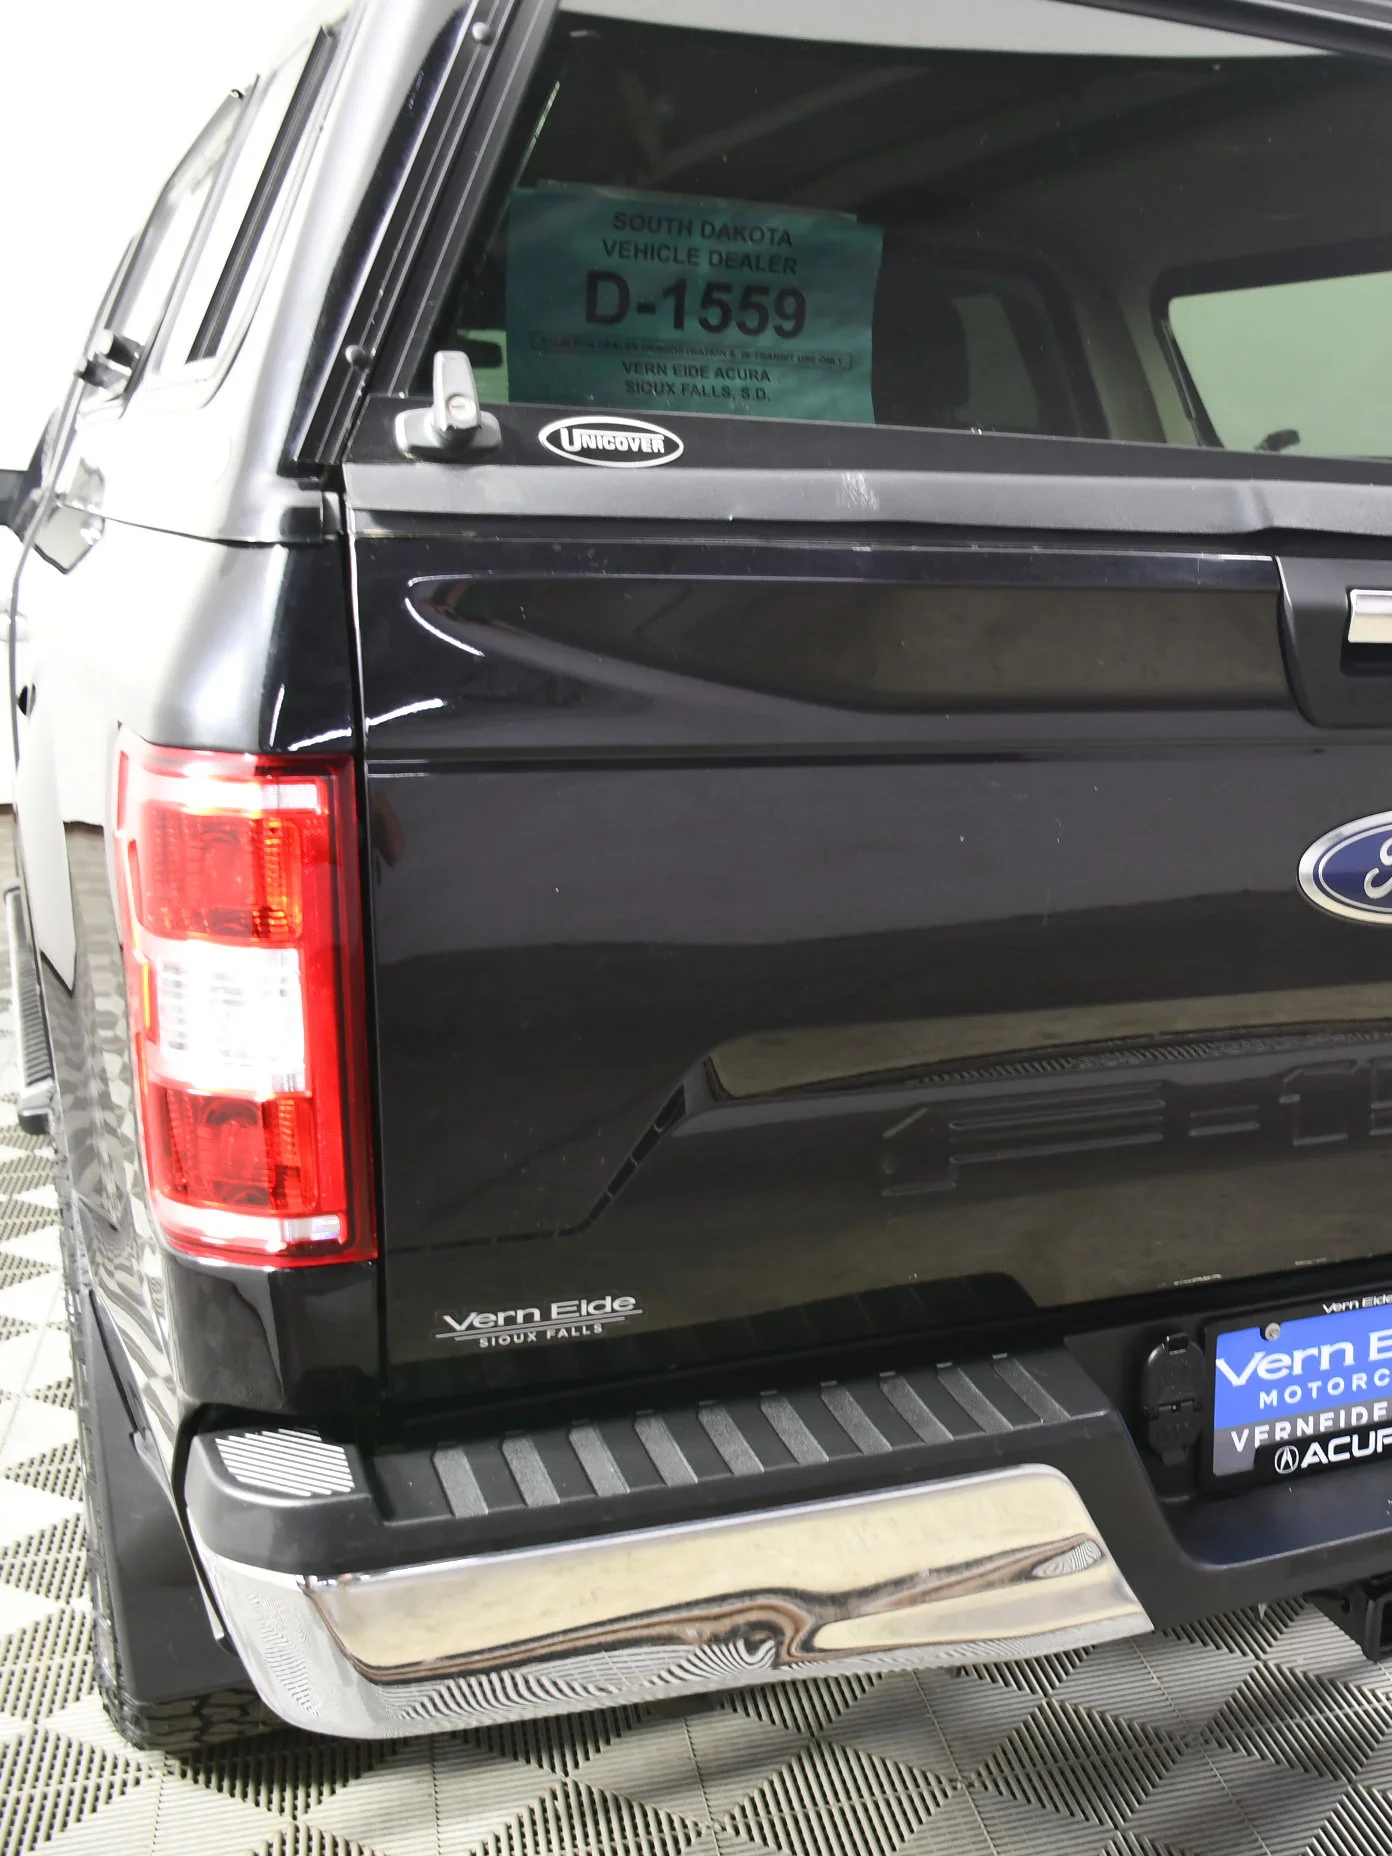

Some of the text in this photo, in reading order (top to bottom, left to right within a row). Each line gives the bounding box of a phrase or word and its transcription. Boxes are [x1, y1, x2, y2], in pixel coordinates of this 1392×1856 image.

[613, 212, 793, 248] SOUTH DAKOTA
[602, 238, 797, 275] VEHICLE DEALER
[586, 270, 806, 339] D-1559
[622, 361, 771, 382] VERN EIDE ACURA
[625, 379, 772, 402] SIOUX FALLS, S.D.
[443, 1296, 637, 1332] Vern Eide
[1322, 1300, 1359, 1314] Vern
[479, 1323, 603, 1348] SIOUX FALLS
[1215, 1340, 1355, 1388] Vern
